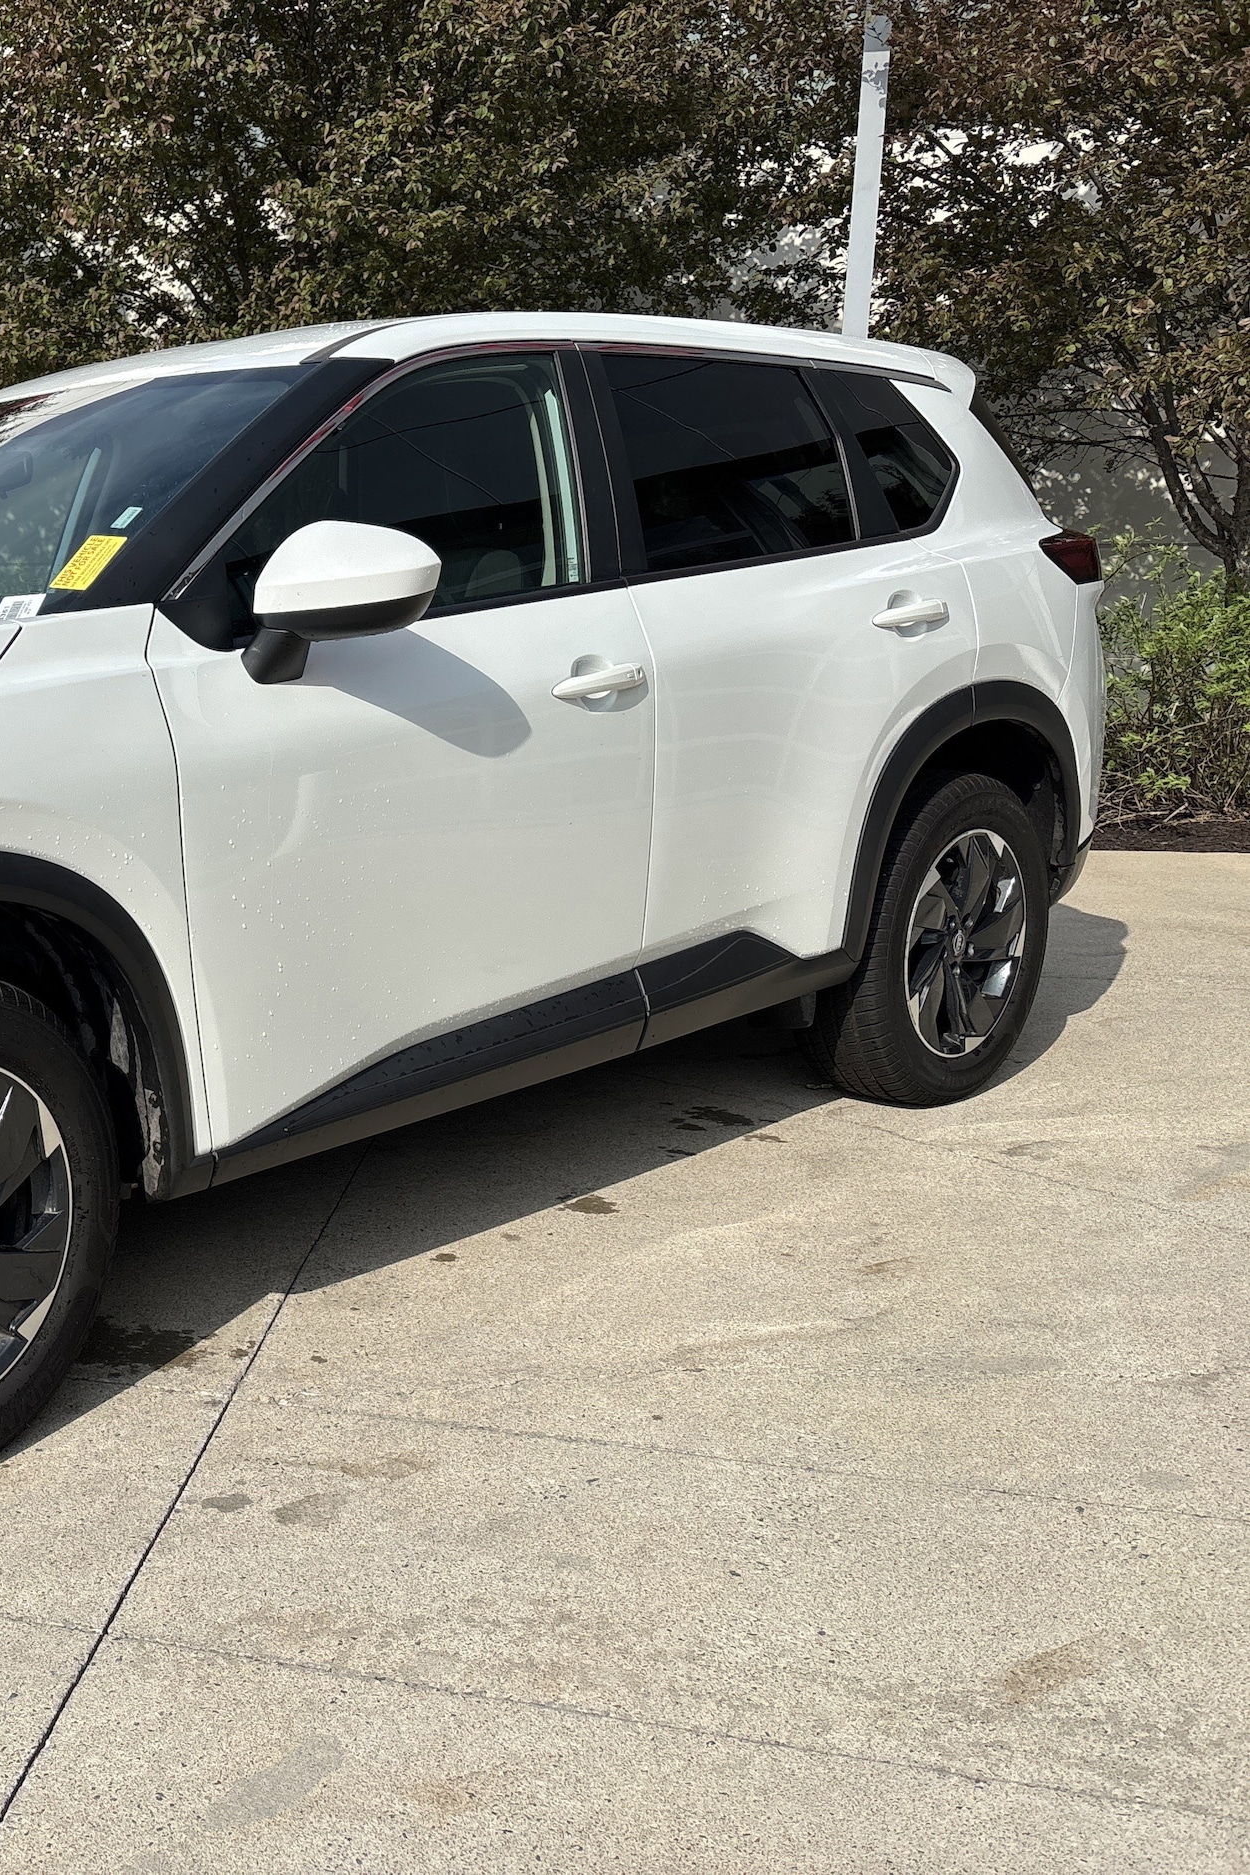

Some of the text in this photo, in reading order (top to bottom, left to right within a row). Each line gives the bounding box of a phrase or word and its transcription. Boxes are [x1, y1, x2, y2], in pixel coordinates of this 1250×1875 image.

[53, 569, 71, 586] THIS
[69, 537, 98, 568] VEHICLE
[62, 571, 77, 586] NOT
[74, 556, 91, 570] FOR
[88, 538, 105, 555] SALE
